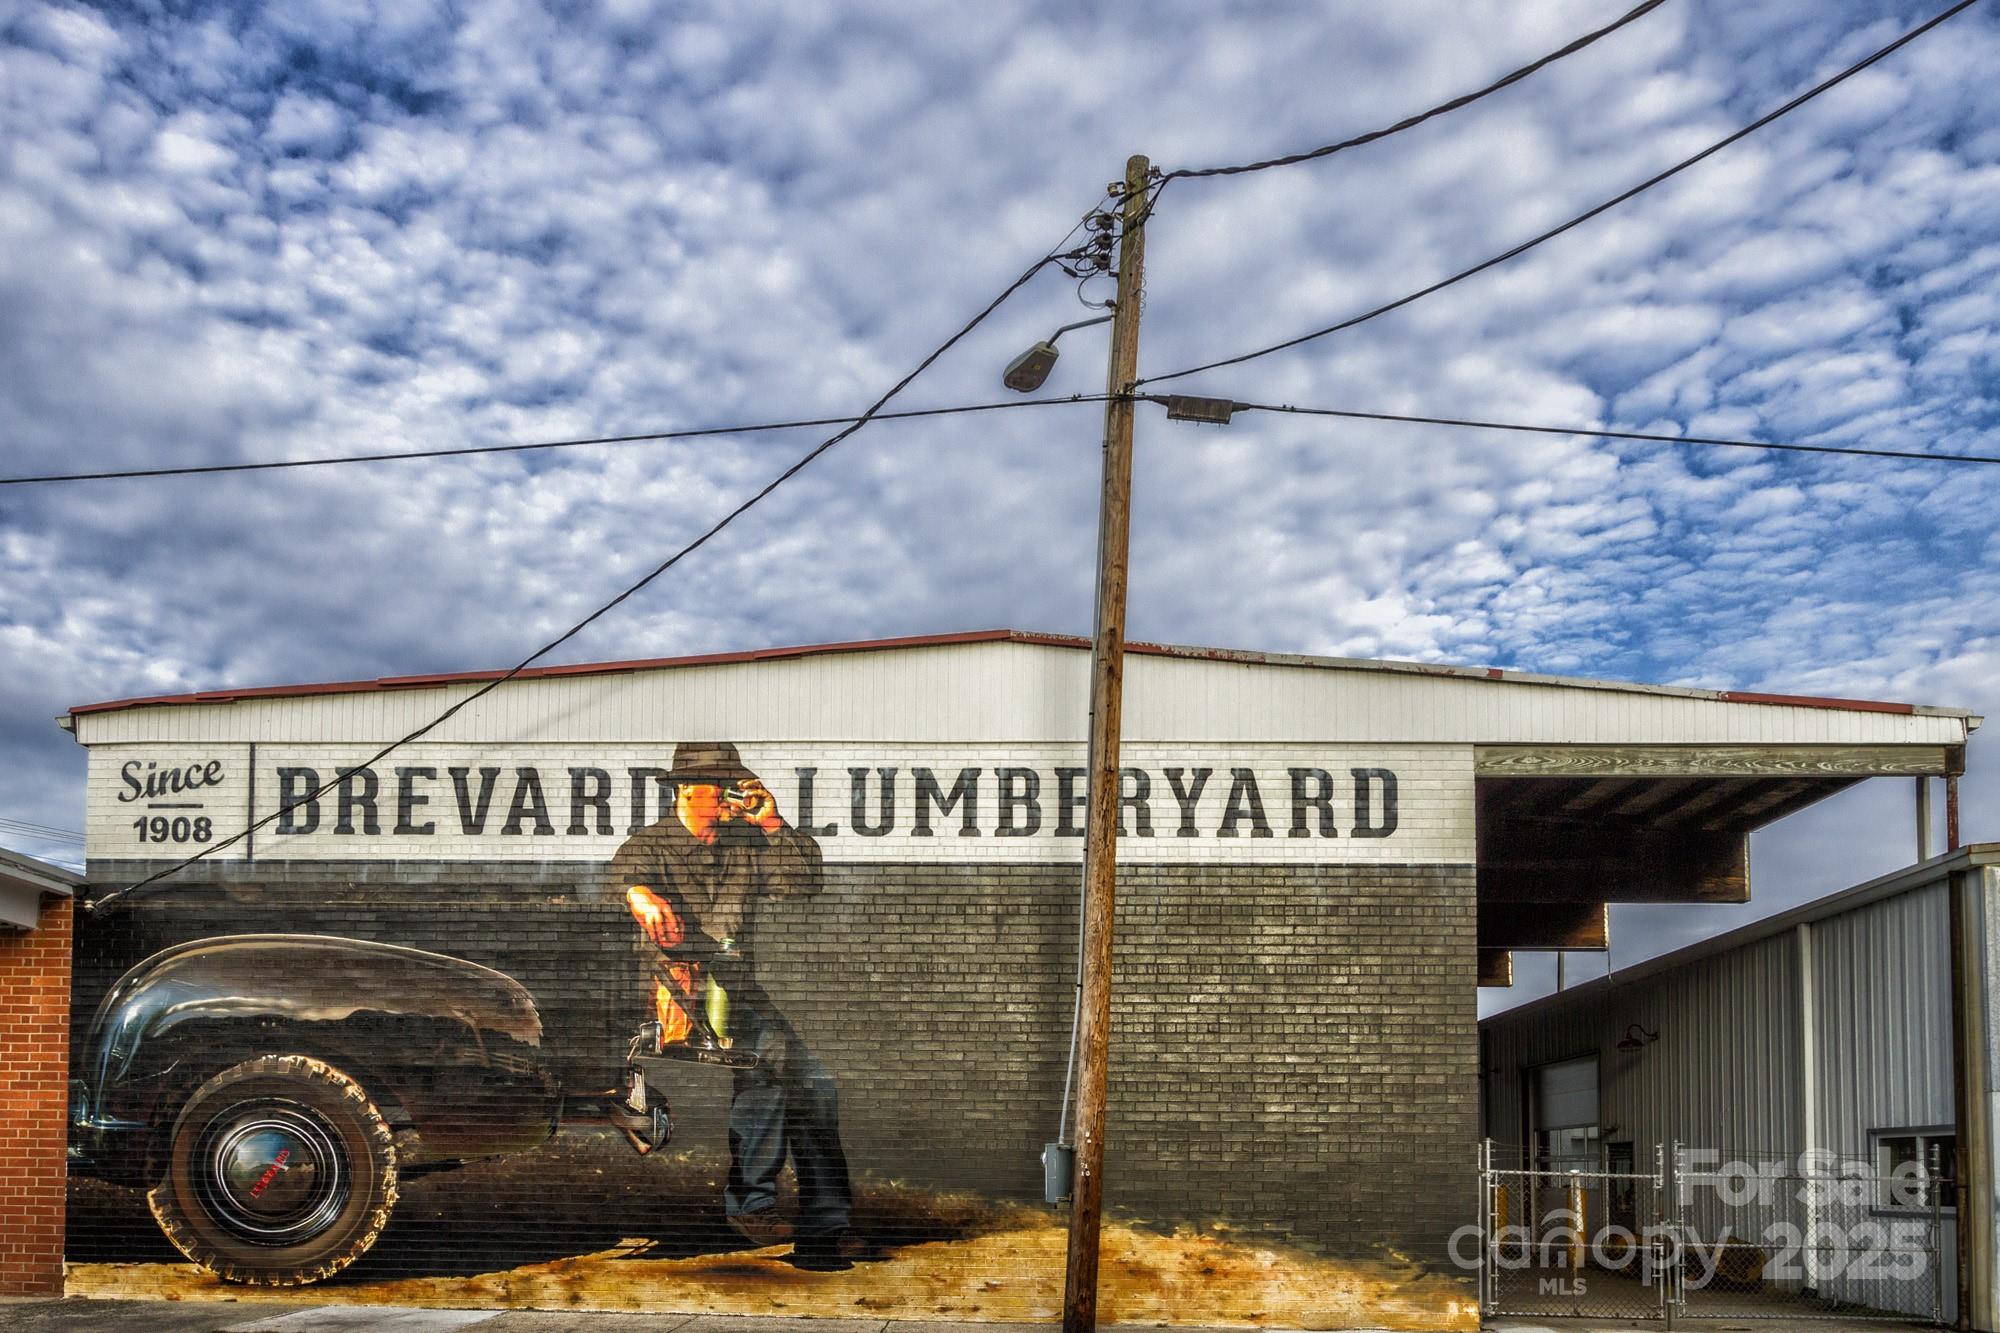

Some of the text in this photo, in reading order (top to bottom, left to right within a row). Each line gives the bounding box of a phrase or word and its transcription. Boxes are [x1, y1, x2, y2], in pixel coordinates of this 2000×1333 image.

[118, 760, 225, 802] Since
[275, 767, 1399, 837] BREVARD LUMBERYARD
[133, 816, 212, 843] 1908
